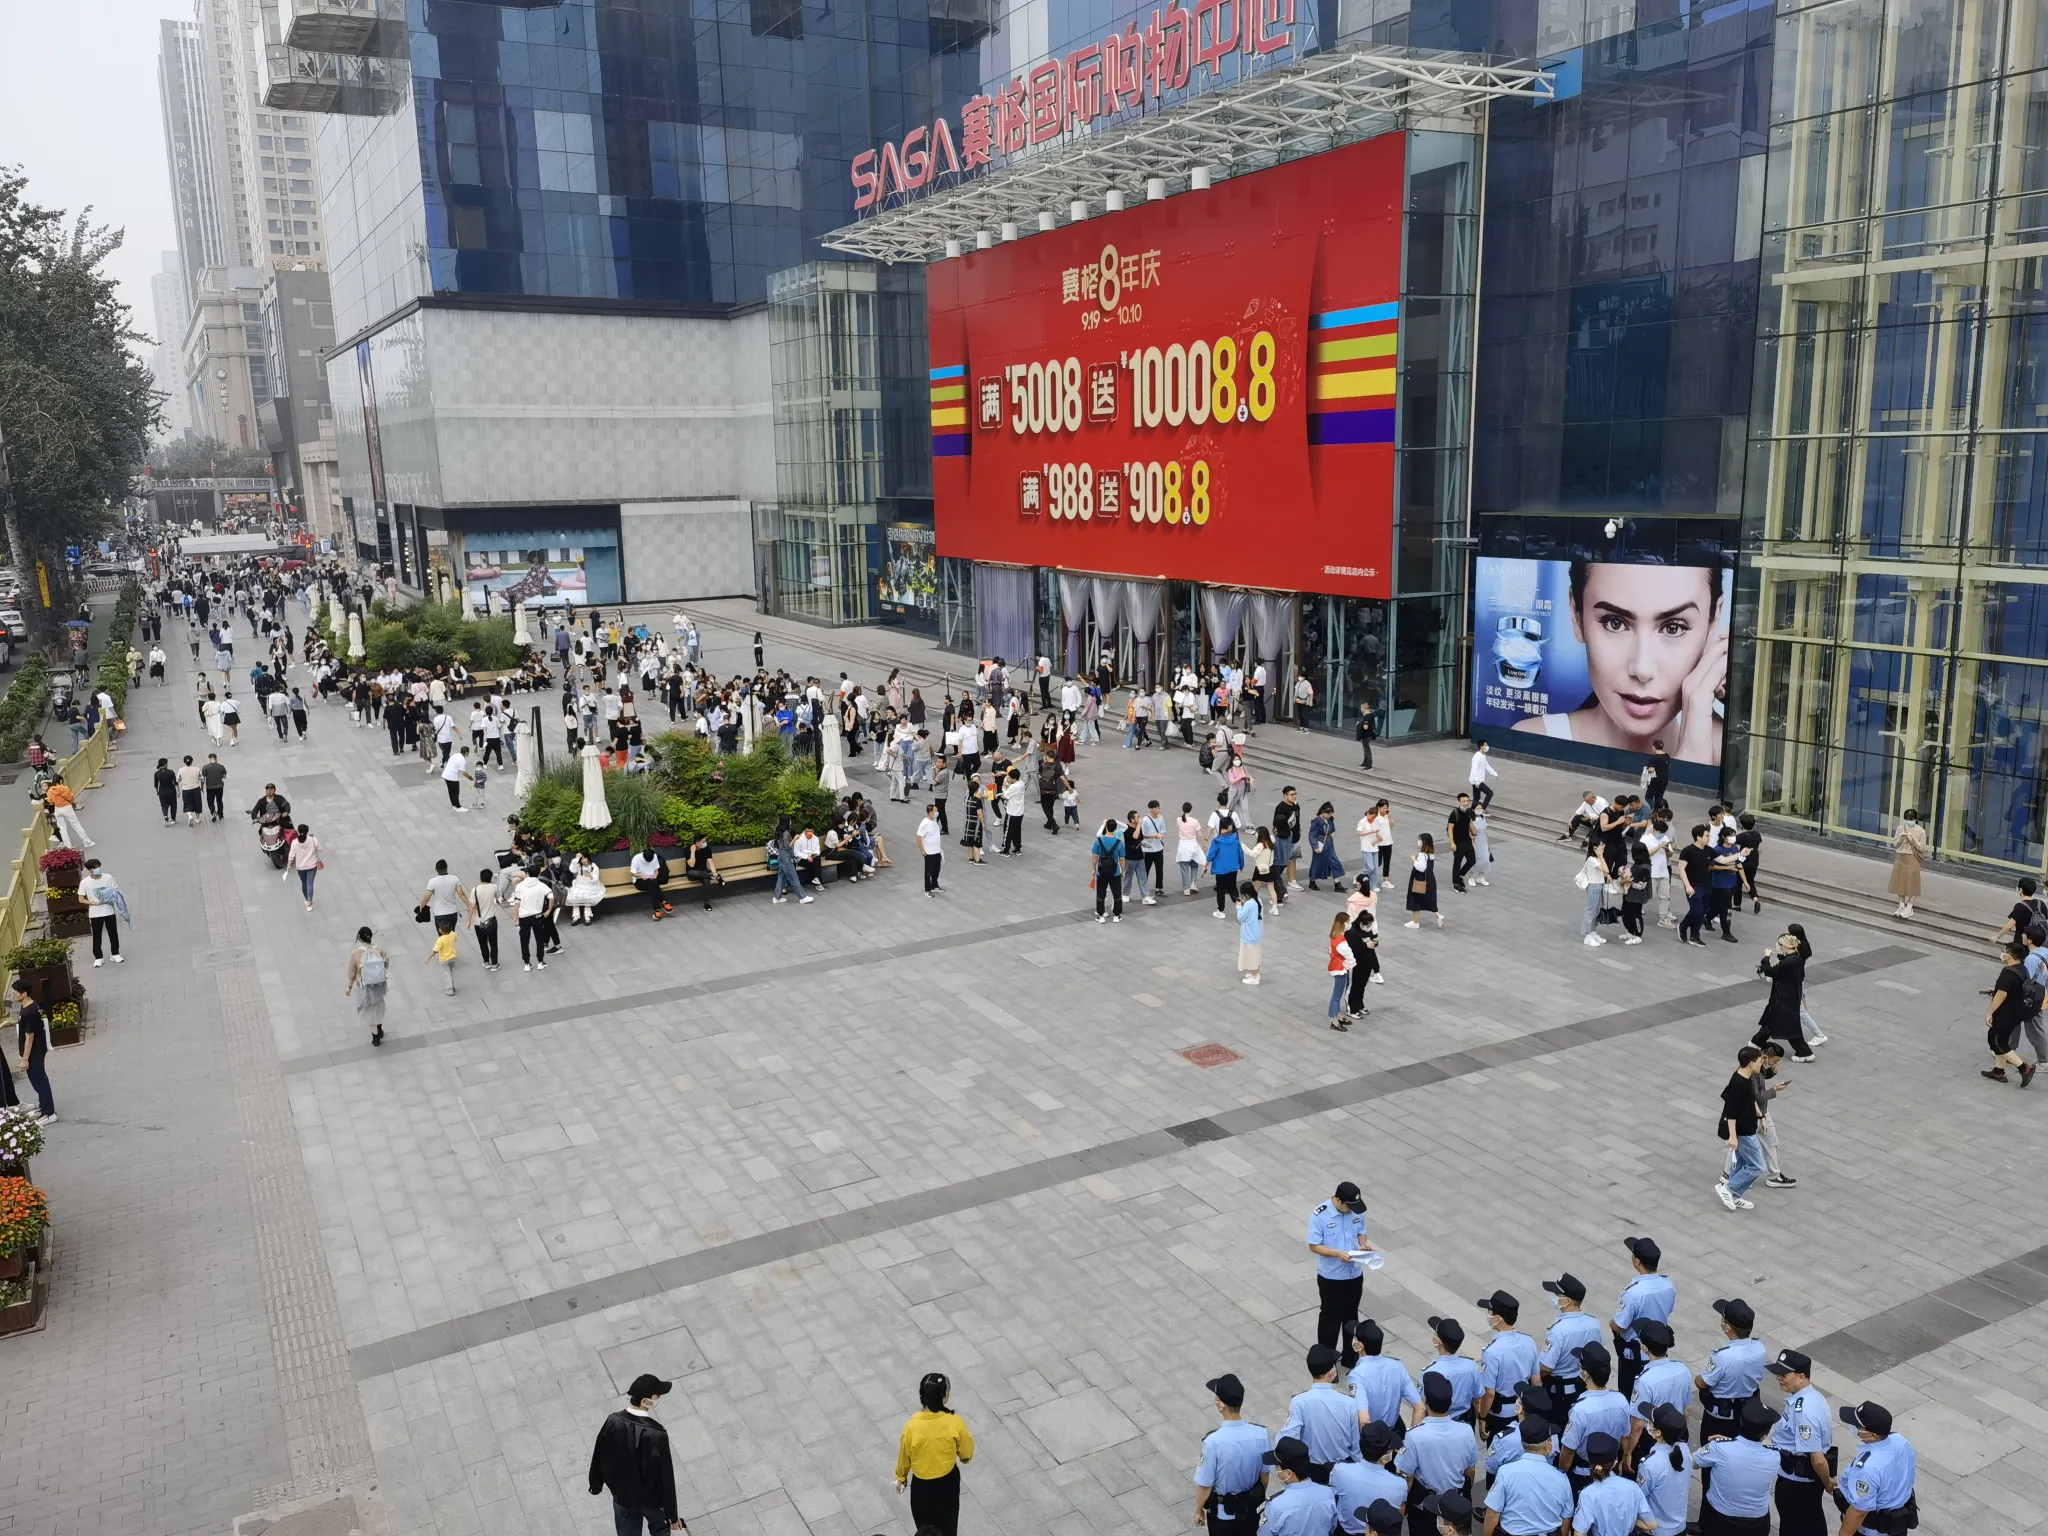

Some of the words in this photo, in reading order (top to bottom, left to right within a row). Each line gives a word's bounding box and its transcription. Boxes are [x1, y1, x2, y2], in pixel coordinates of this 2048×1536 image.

[851, 116, 961, 210] SAGA
[960, 0, 1296, 171] 赛格国际购物中心
[1062, 244, 1161, 311] 赛格8年庆
[981, 382, 1000, 422] 满
[1091, 369, 1115, 414] 送
[1023, 477, 1039, 509] 满
[1099, 475, 1119, 512] 送
